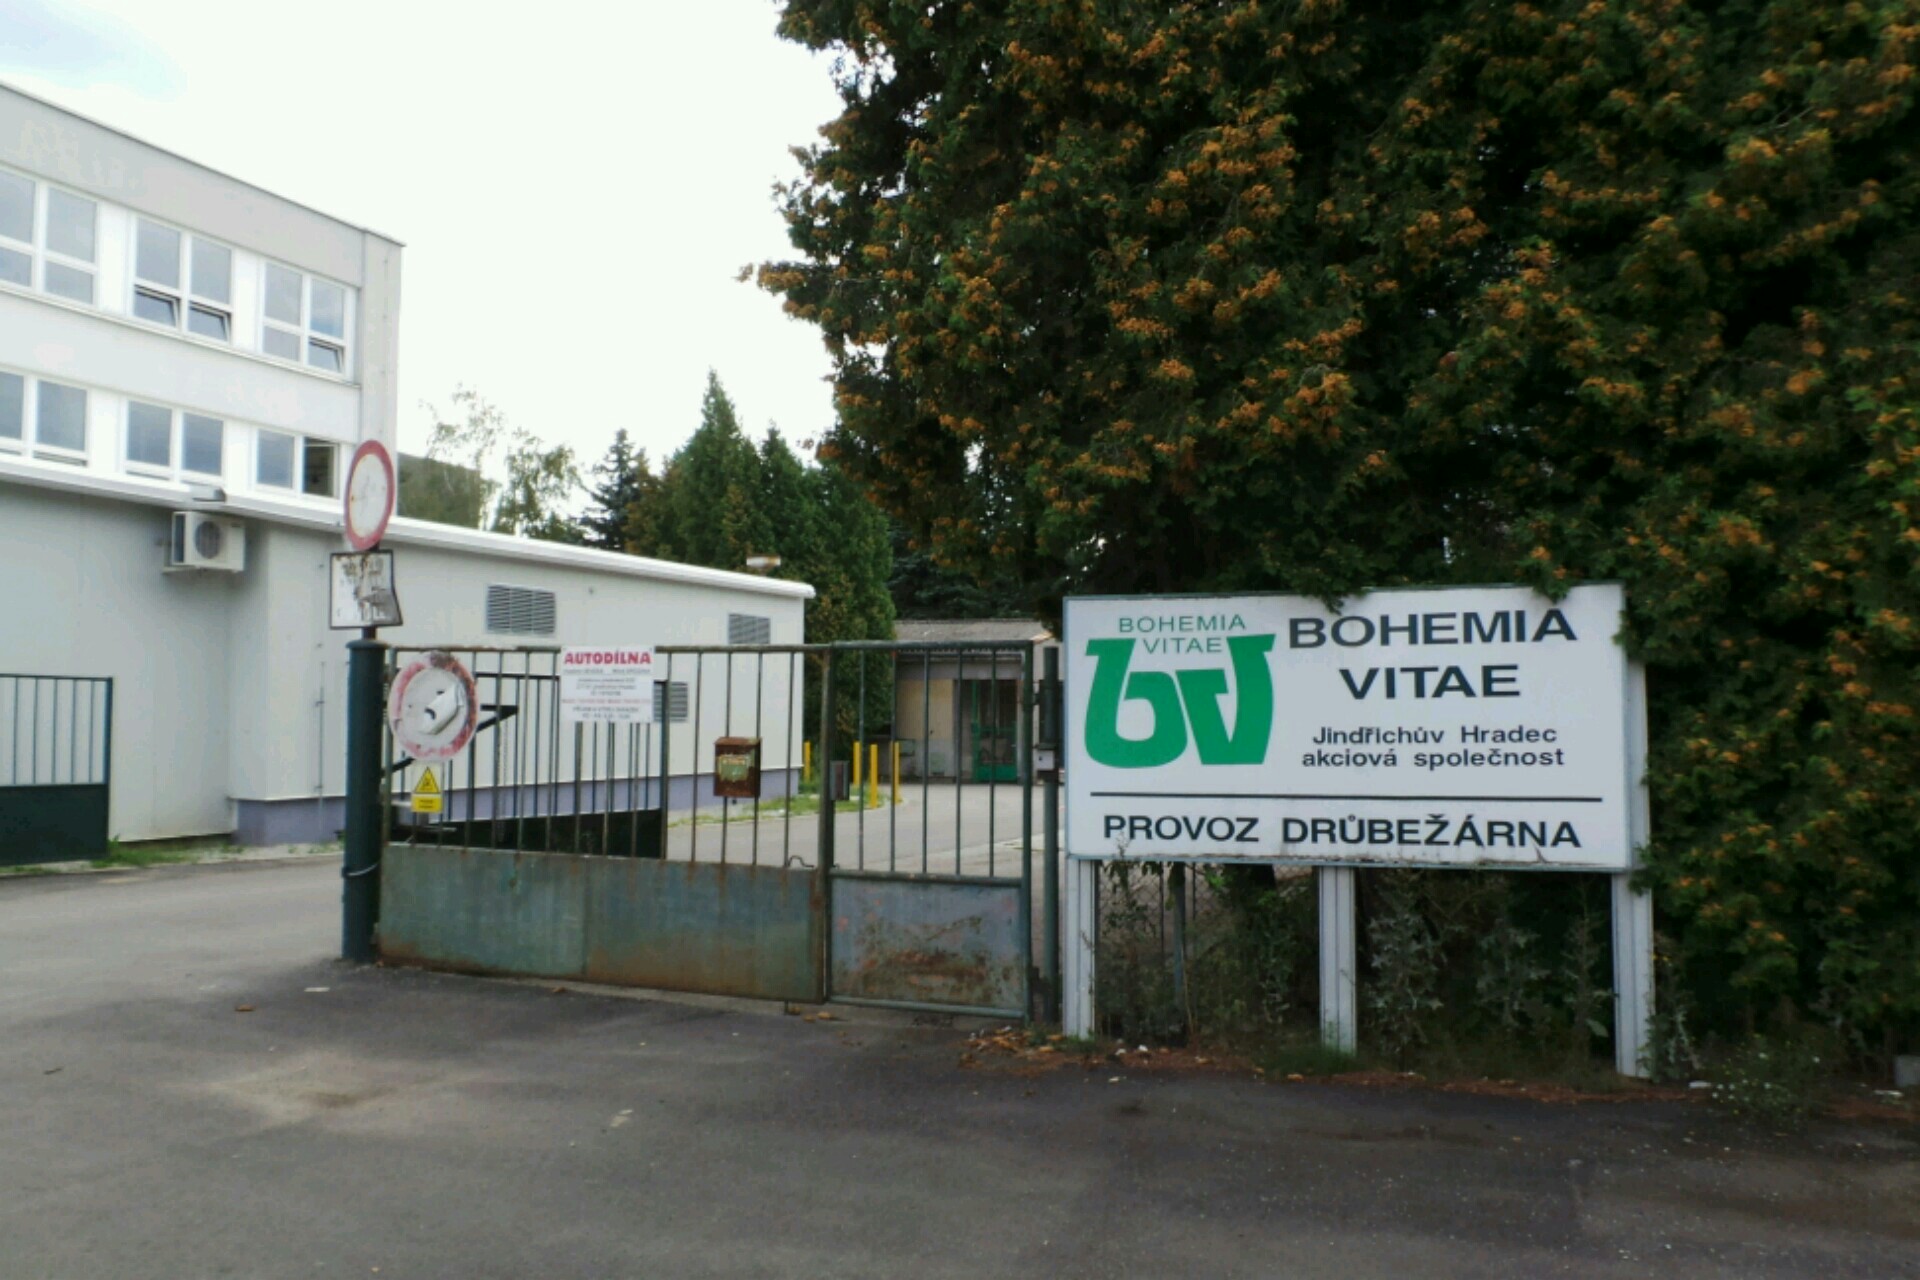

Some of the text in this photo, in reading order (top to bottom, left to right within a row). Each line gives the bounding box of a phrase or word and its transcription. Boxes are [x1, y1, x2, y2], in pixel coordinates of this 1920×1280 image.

[1119, 614, 1246, 633] BOHEMIA
[1289, 608, 1578, 649] BOHEMIA
[1143, 636, 1223, 655] VITAE
[1338, 664, 1521, 700] VITAE
[1312, 726, 1558, 745] Jindřichův Hradec
[1301, 748, 1564, 771] akciová společnost
[1103, 814, 1582, 848] PROVOZ DRŮBEŽÁRNA
